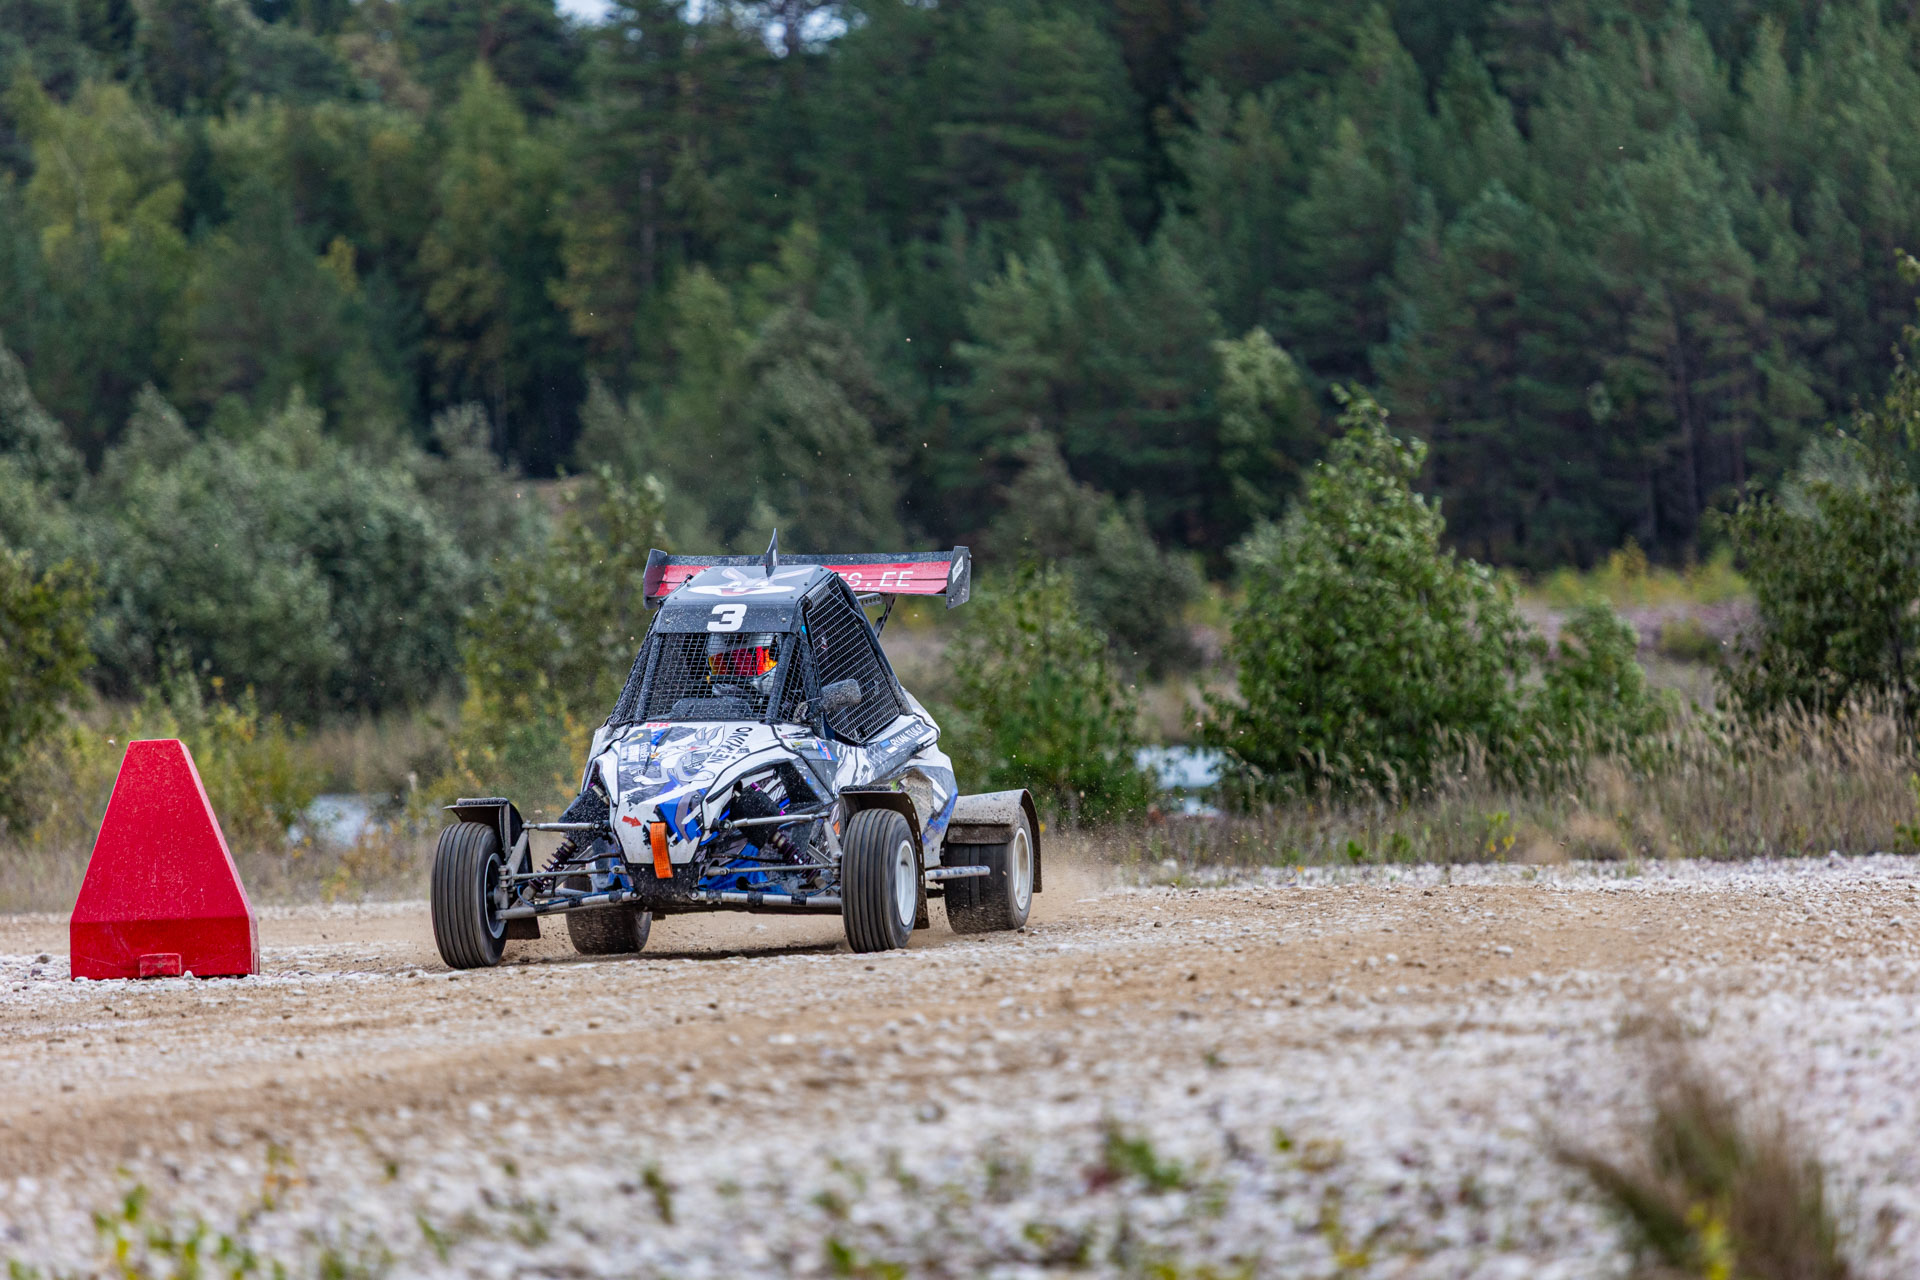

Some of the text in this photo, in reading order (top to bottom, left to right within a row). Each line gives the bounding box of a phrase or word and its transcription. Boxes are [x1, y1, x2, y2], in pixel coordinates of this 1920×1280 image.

[838, 571, 914, 587] S.EE
[706, 604, 748, 632] 3
[890, 724, 924, 747] RYAN TULP
